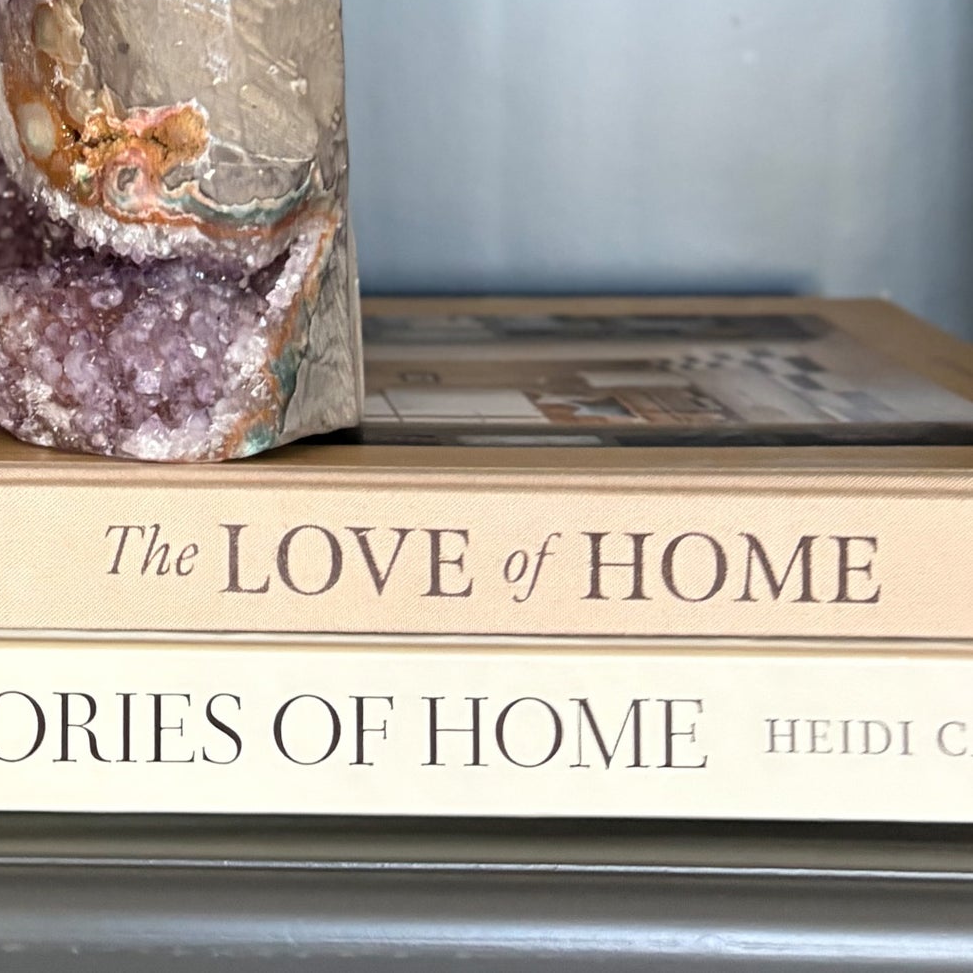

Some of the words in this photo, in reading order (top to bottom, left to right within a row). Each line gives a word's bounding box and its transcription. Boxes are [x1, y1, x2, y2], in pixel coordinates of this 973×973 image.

[105, 523, 199, 577] The
[219, 524, 474, 599] LOVE
[503, 532, 562, 604] of
[580, 530, 882, 605] HOME
[272, 694, 395, 767] OF
[420, 696, 709, 770] HOME
[764, 718, 914, 756] HEIDI
